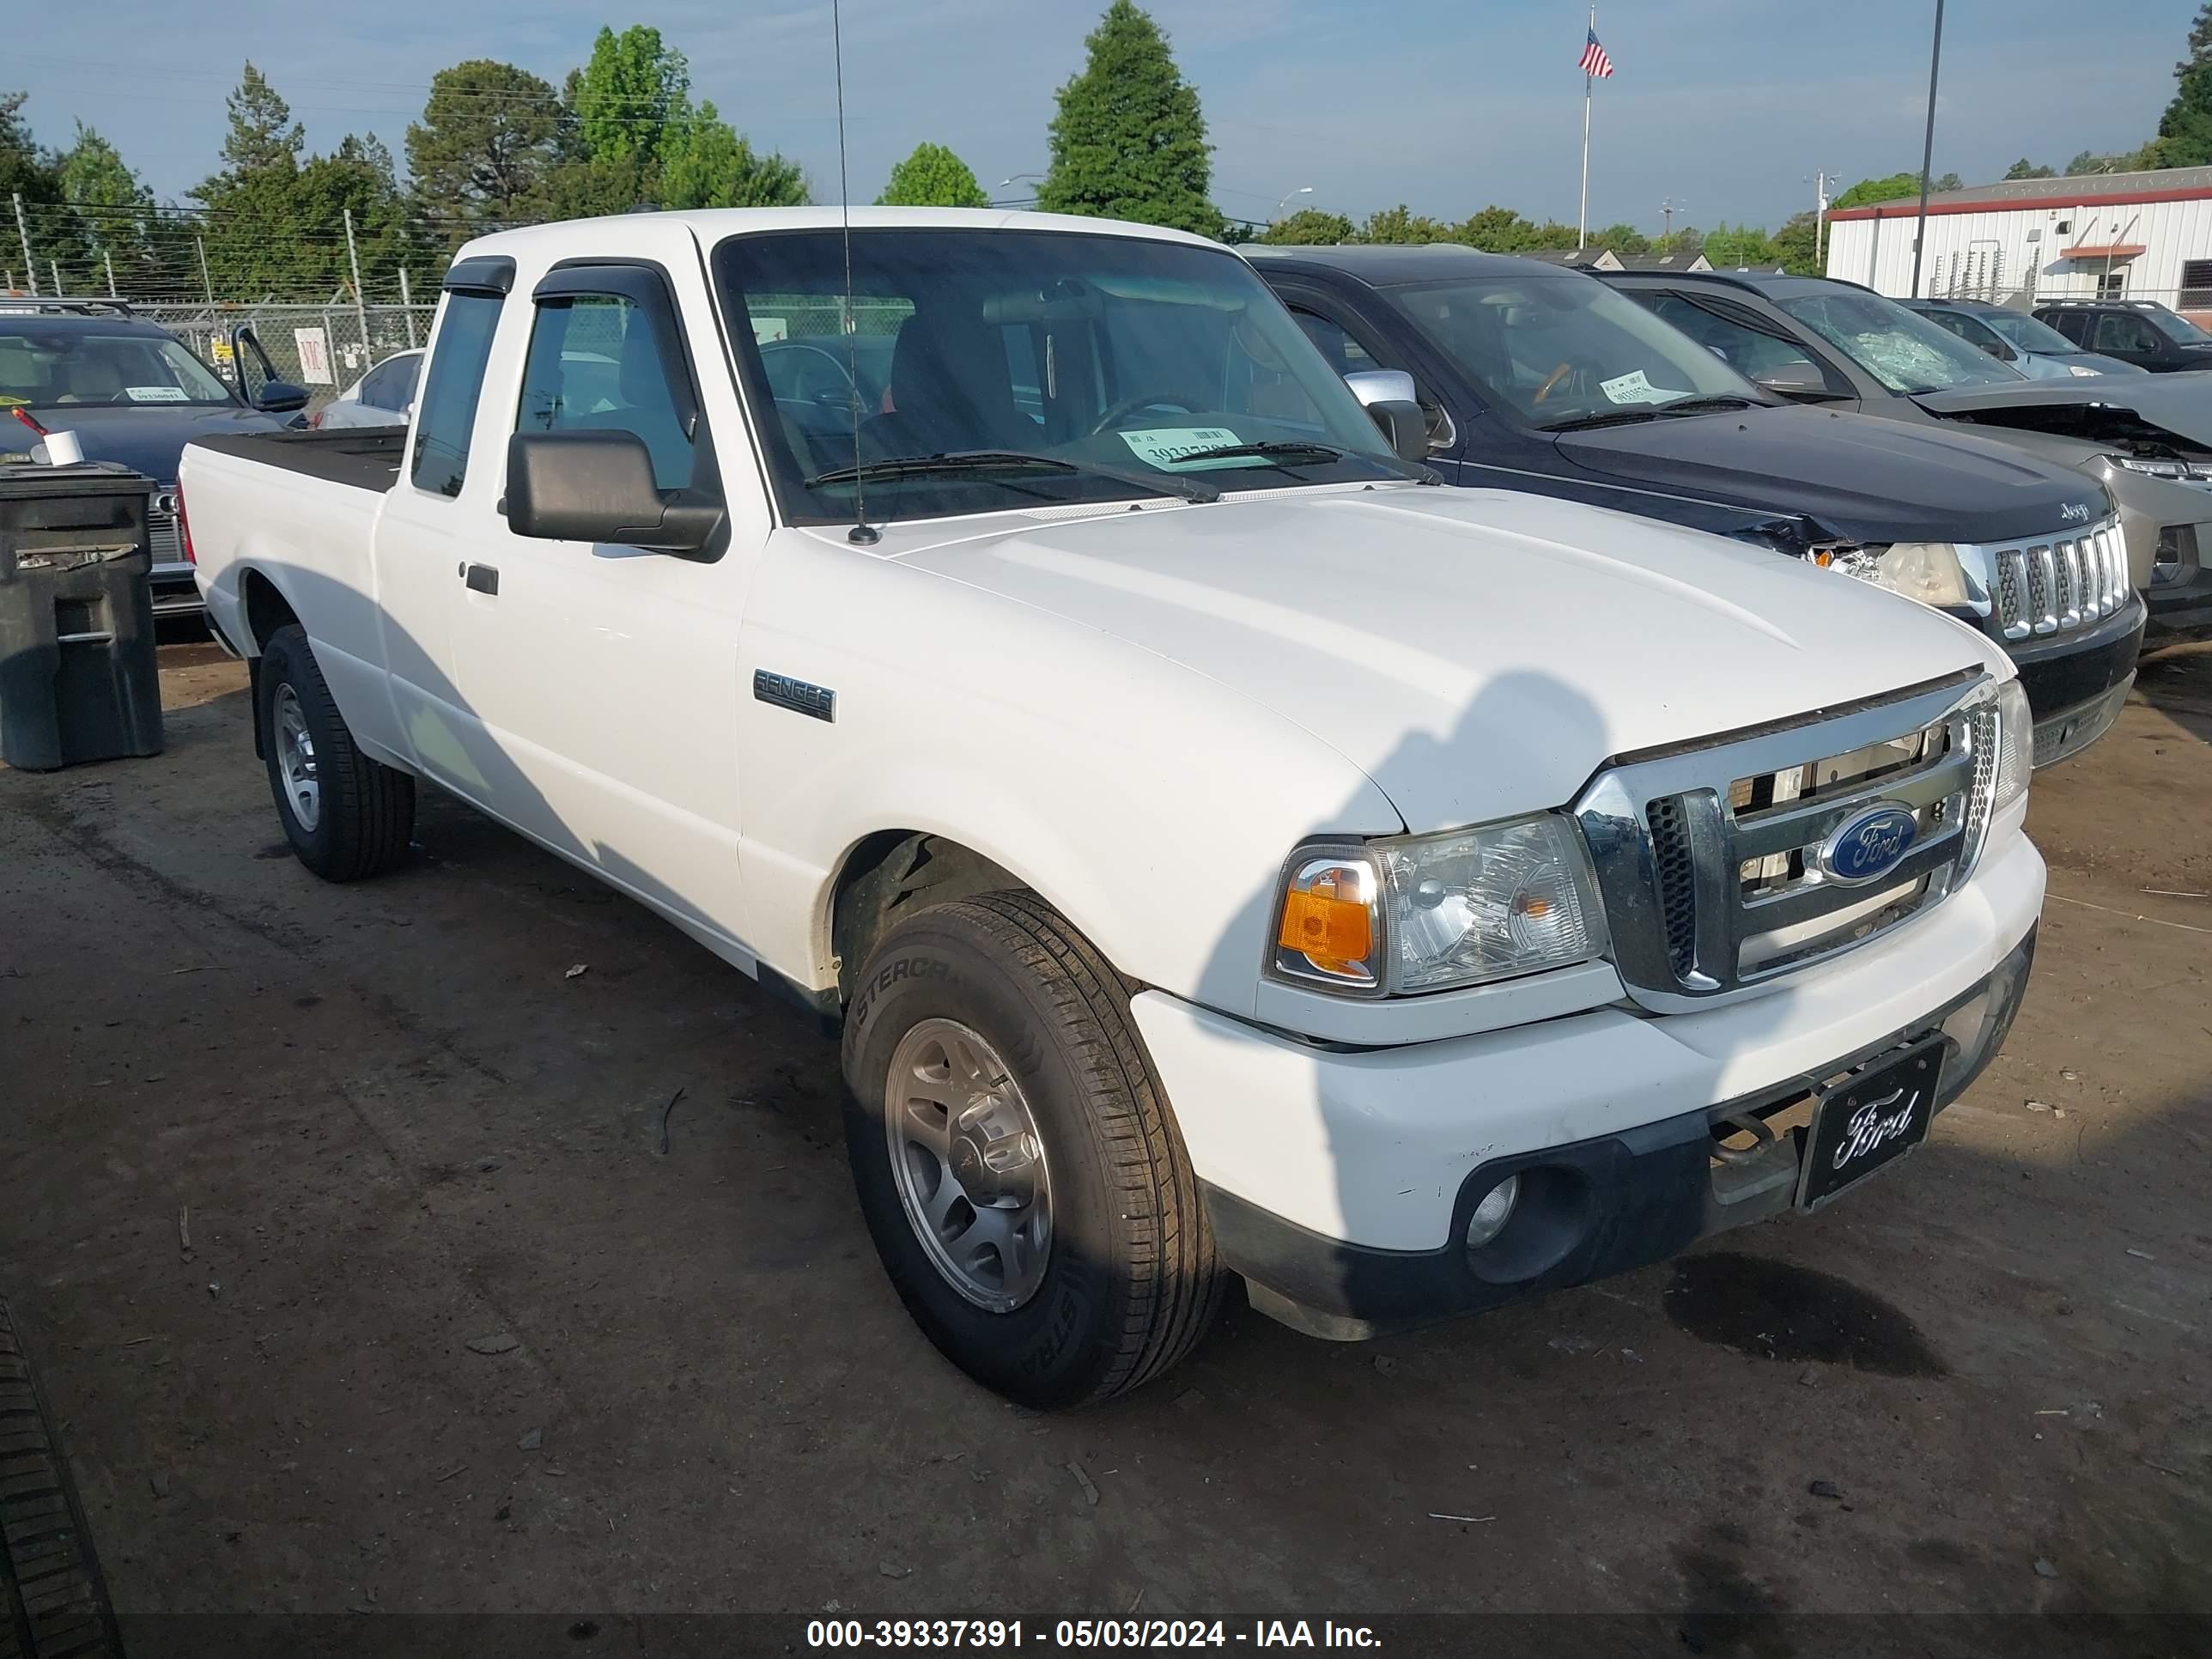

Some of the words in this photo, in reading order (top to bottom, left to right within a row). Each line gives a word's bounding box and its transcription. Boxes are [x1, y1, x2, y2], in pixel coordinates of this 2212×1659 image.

[2060, 503, 2090, 521] Jeep
[756, 671, 831, 710] RANGER
[1852, 820, 1903, 867] Ford
[1832, 1088, 1920, 1170] Ford
